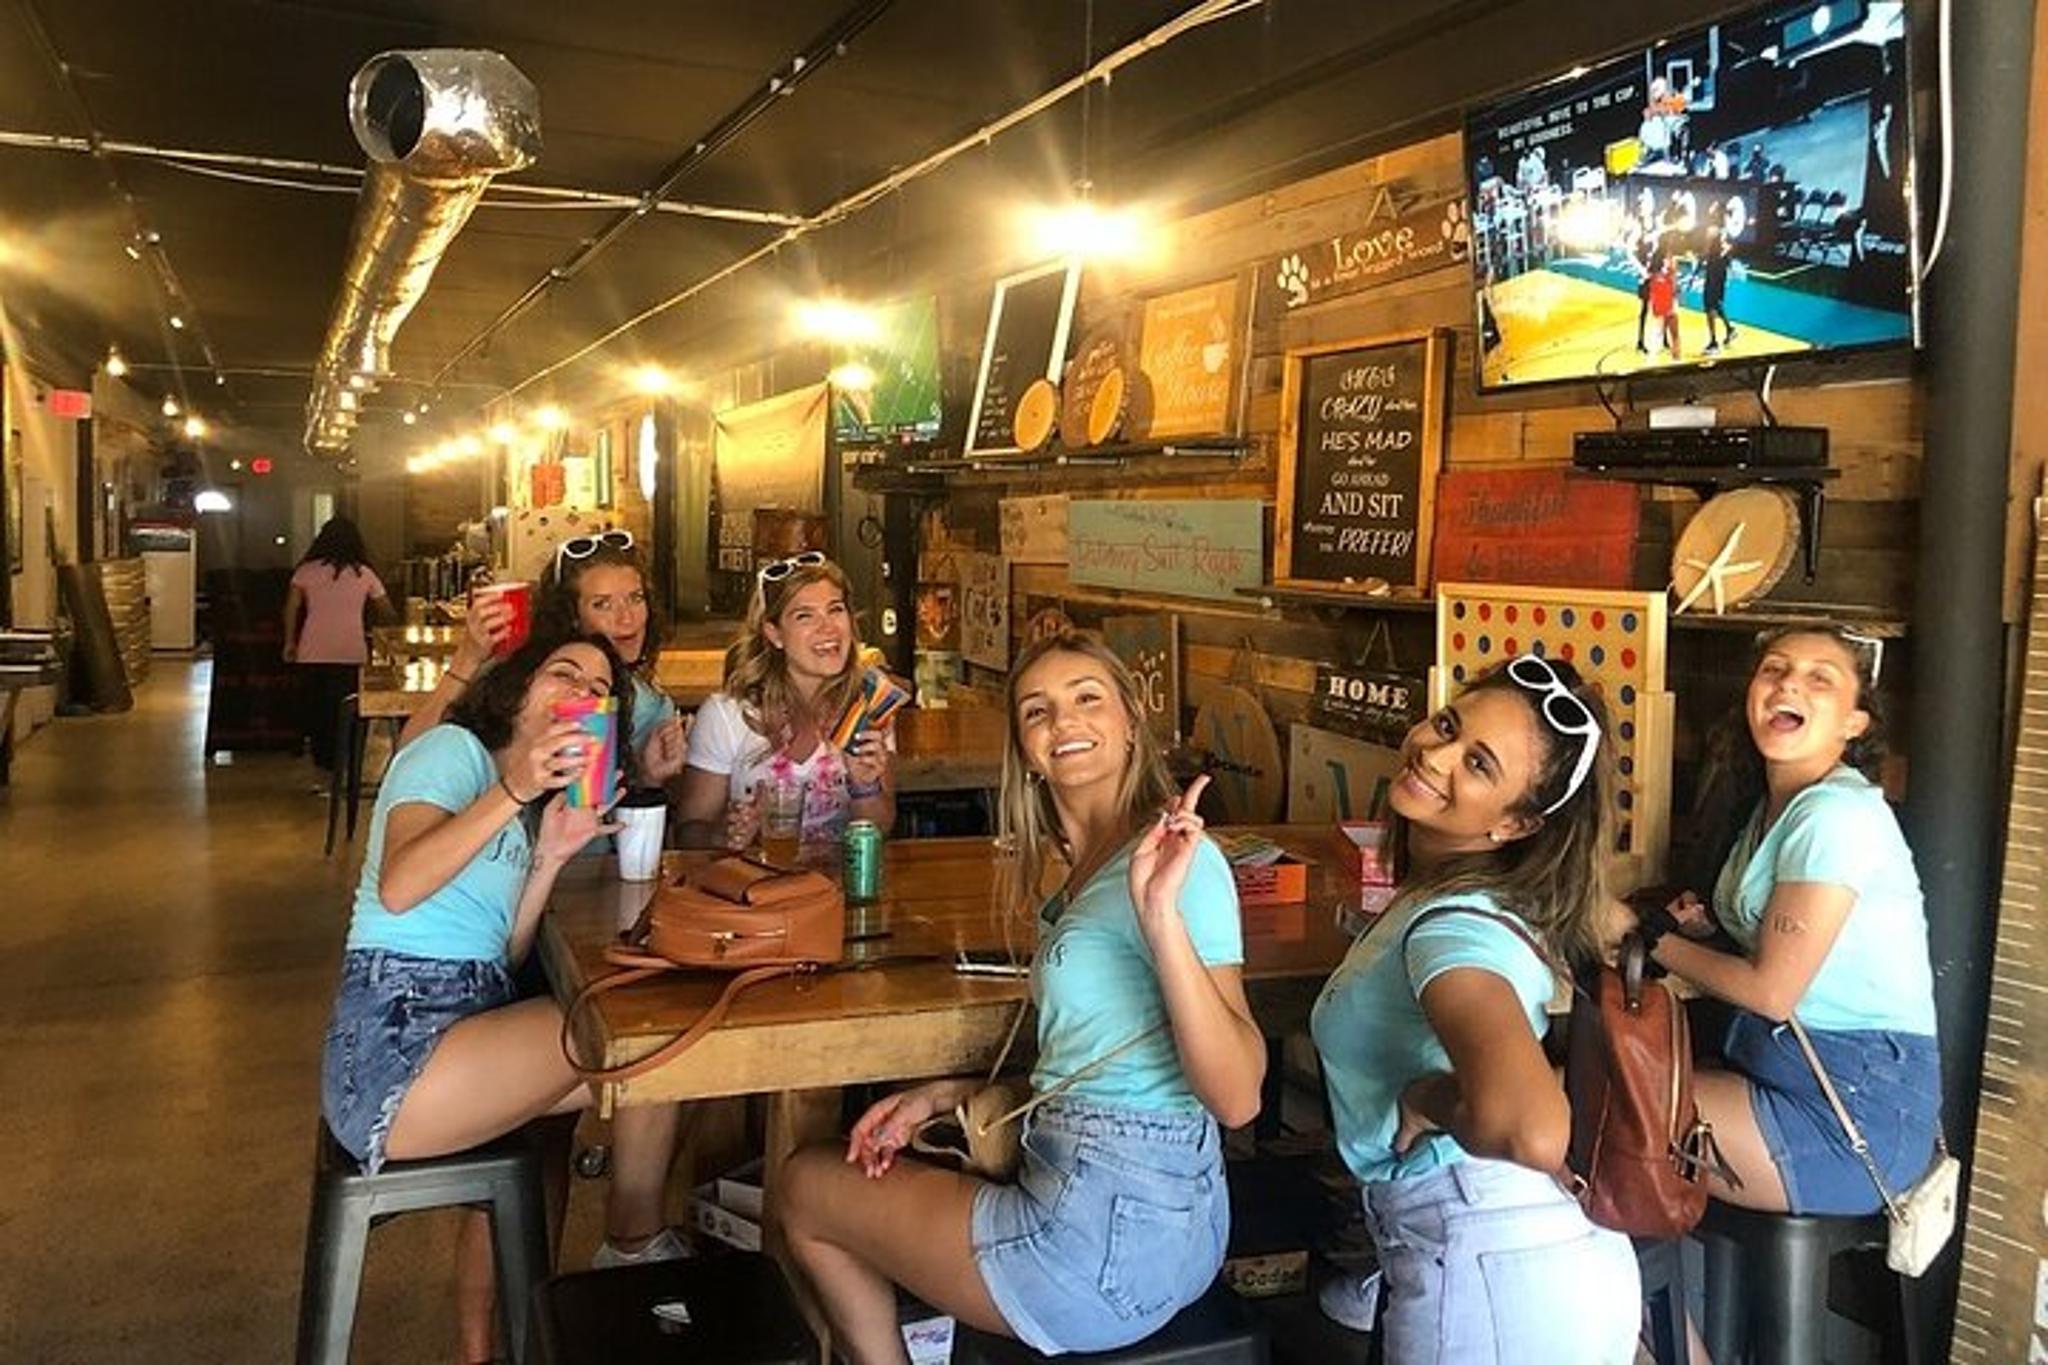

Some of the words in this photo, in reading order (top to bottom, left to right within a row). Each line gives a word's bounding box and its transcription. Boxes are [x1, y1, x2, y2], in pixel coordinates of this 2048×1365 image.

[1332, 226, 1415, 272] Love
[1364, 431, 1412, 450] MAD
[1320, 492, 1364, 516] AND
[1367, 492, 1403, 518] SIT
[1337, 528, 1414, 556] PREFER!
[1327, 675, 1410, 711] HOME
